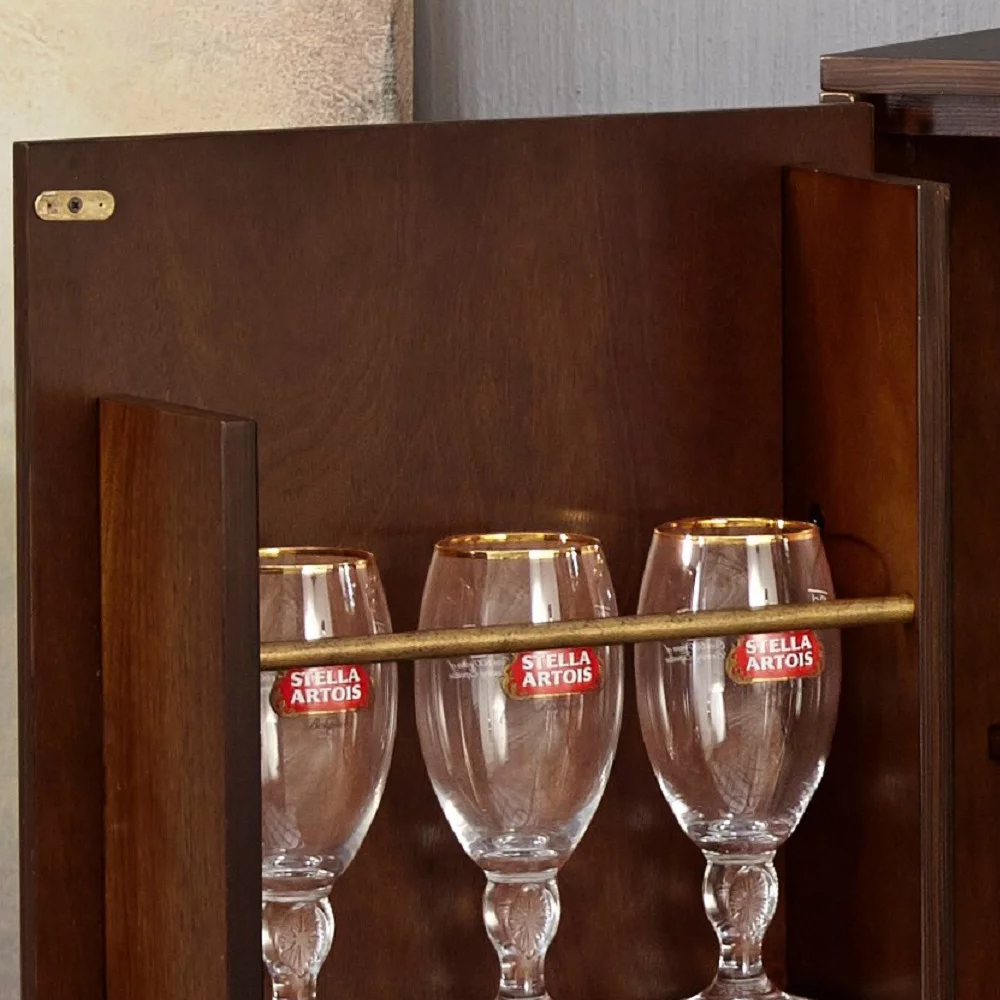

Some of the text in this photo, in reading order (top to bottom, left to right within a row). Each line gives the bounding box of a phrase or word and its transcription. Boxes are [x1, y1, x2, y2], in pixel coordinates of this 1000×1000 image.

[744, 635, 813, 655] STELLA
[521, 650, 591, 671] STELLA
[745, 651, 814, 672] ARTOIS
[290, 667, 361, 687] STELLA
[521, 667, 593, 688] ARTOIS
[290, 684, 362, 705] ARTOIS
